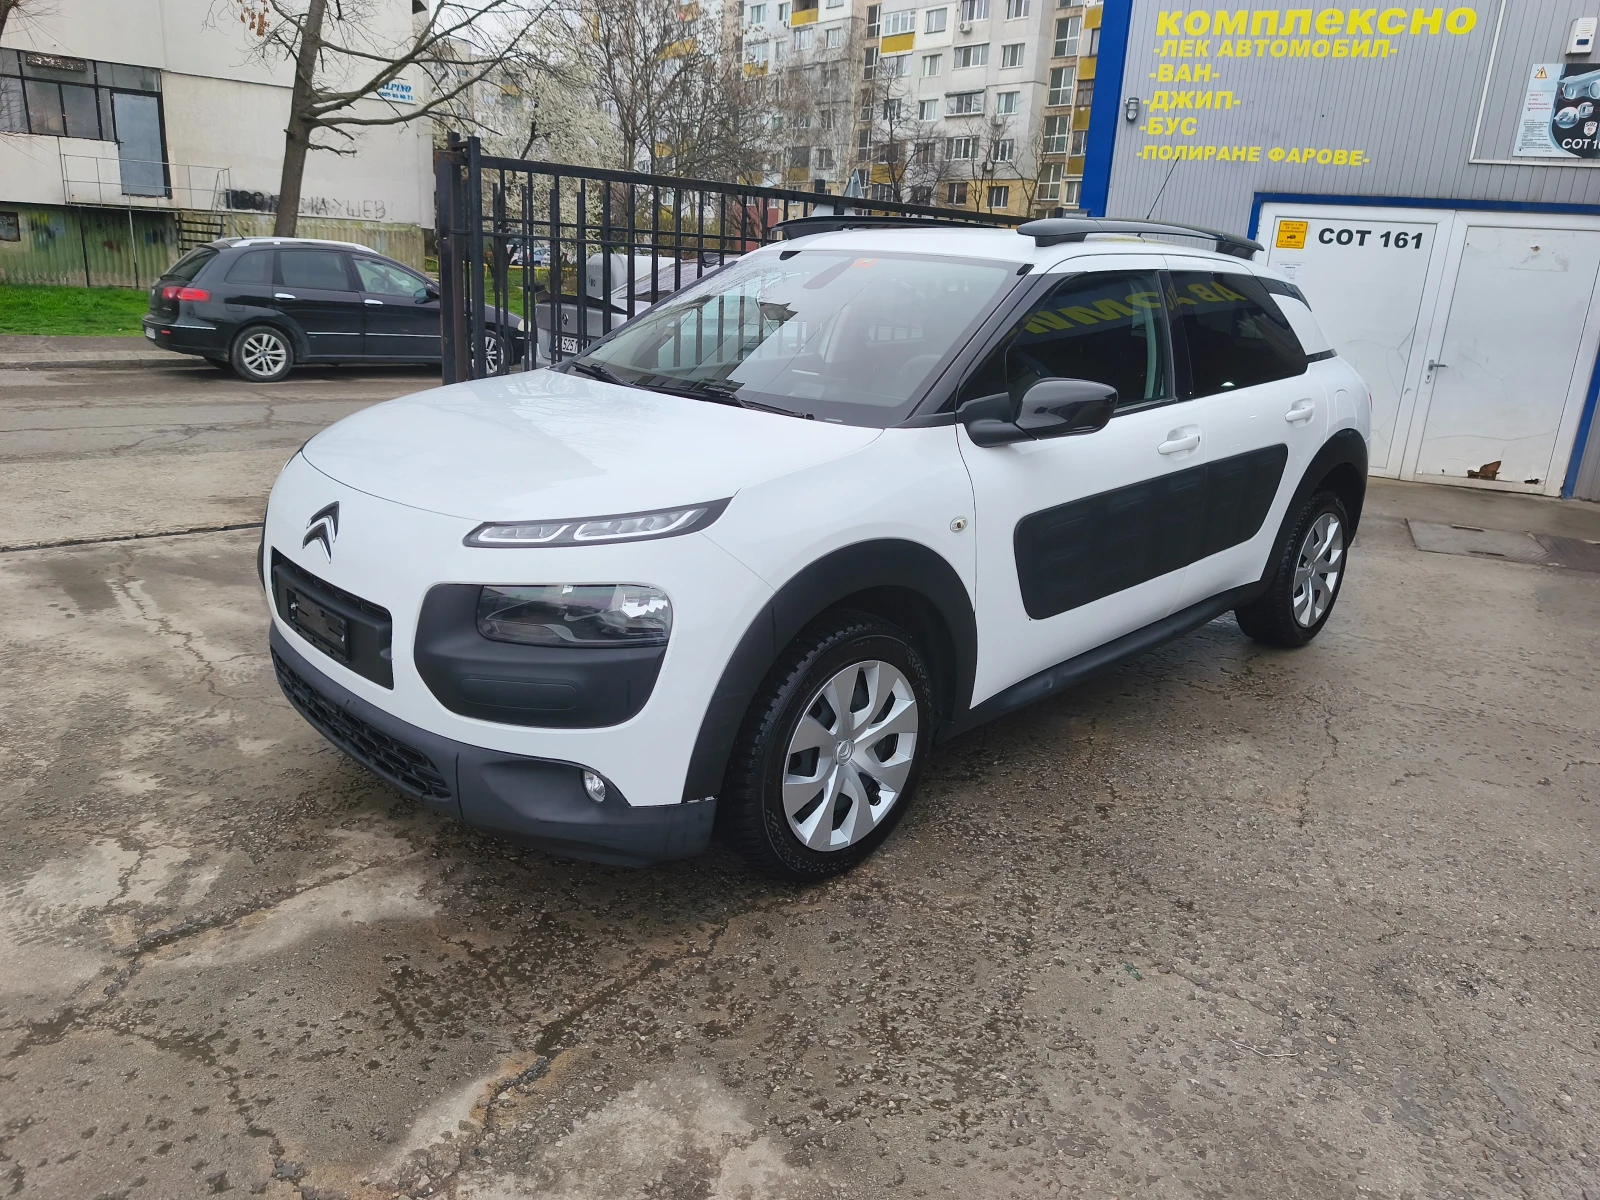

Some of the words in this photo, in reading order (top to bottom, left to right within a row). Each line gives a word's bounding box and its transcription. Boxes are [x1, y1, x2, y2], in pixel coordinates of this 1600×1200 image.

[1153, 39, 1210, 58] -ЛЕК
[1217, 39, 1398, 58] АВТОМОБИЛ-
[1149, 64, 1220, 83] -ВАН-
[1143, 91, 1241, 113] -ДЖИП-
[1139, 117, 1198, 136] -БУС
[1592, 139, 1600, 149] 1
[1136, 146, 1261, 162] -ПОЛИРАНЕ
[1267, 148, 1370, 167] ФАРОВЕ-
[1379, 231, 1423, 250] 161
